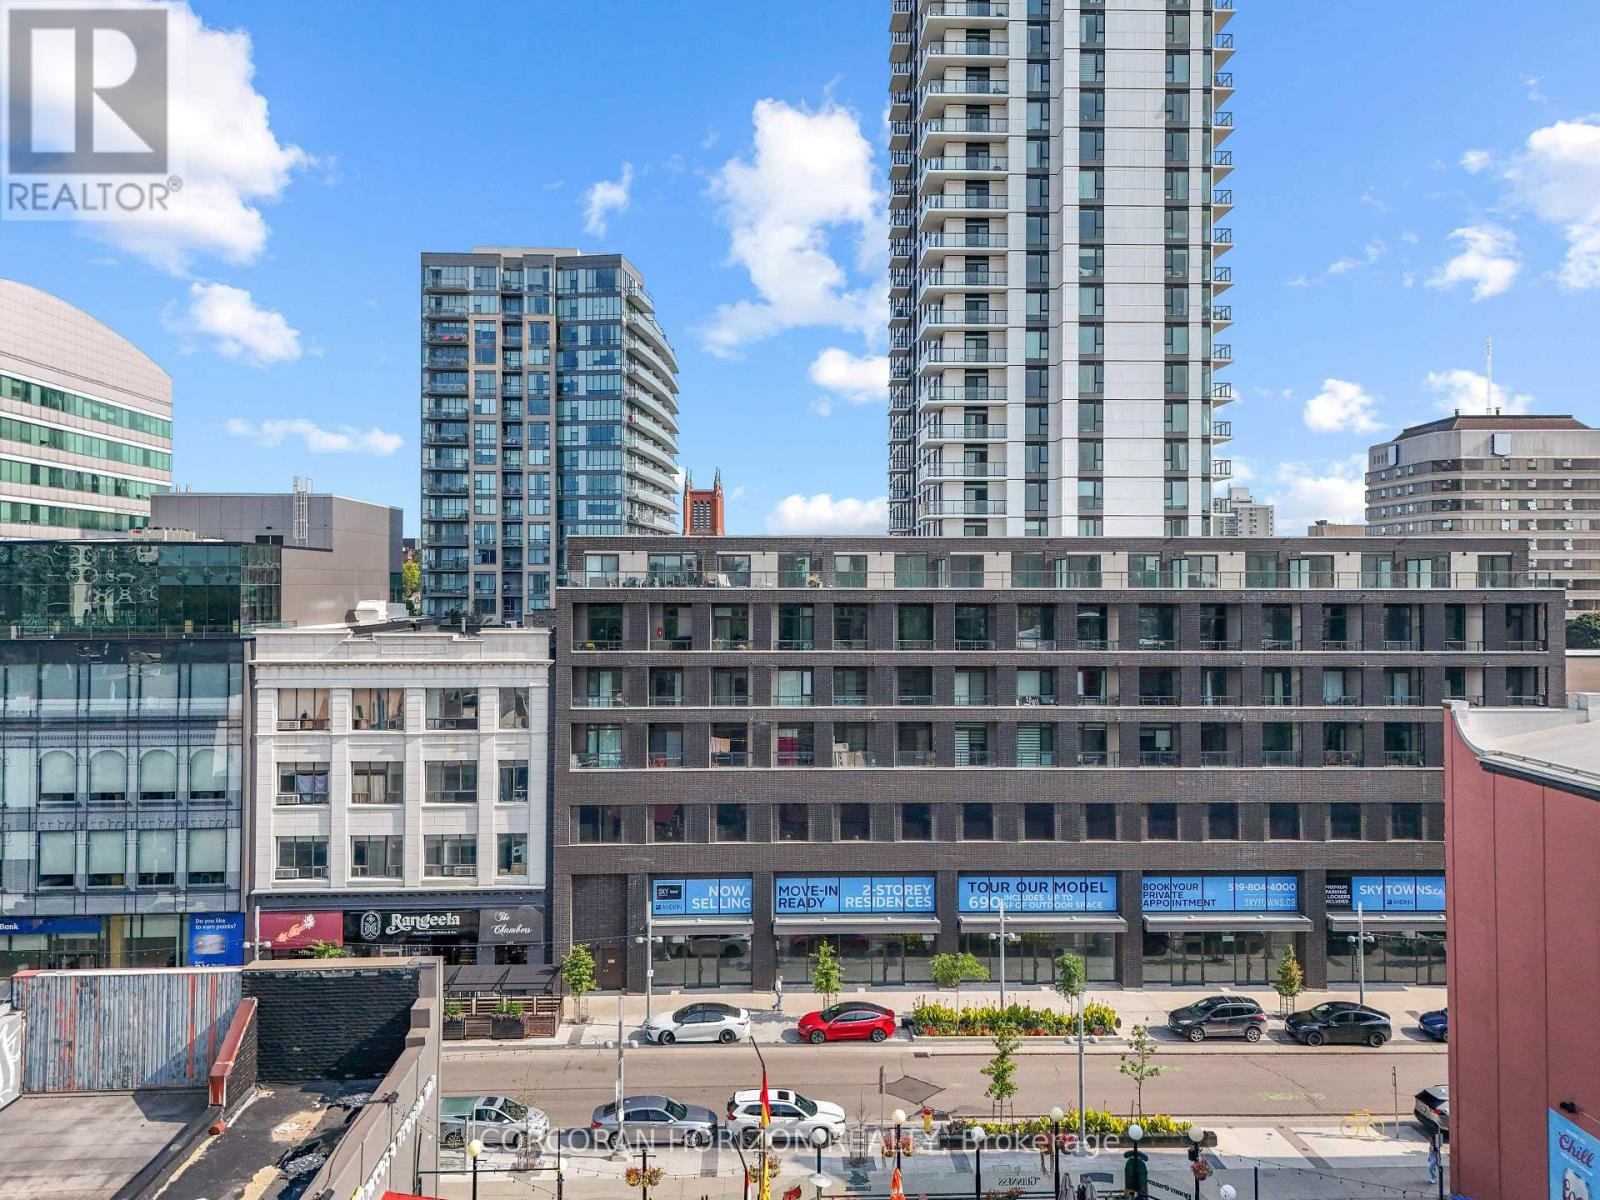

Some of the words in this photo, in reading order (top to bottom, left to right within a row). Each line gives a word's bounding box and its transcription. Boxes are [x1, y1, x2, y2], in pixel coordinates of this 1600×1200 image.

[708, 885, 745, 897] NOW
[778, 885, 838, 896] MOVE-IN
[862, 884, 930, 896] 2-STOREY
[968, 882, 1009, 893] TOUR
[1016, 882, 1048, 893] OUR
[1054, 882, 1108, 893] MODEL
[1143, 883, 1169, 891] BOOK
[1172, 883, 1198, 891] YOUR
[1228, 883, 1296, 892] 519-804-4000
[692, 897, 751, 909] SELLING
[778, 897, 826, 908] READY
[845, 896, 932, 908] RESIDENCES
[969, 896, 1001, 909] 690
[0, 922, 19, 930] Bank
[385, 913, 460, 934] Rangeela
[490, 923, 532, 936] Chambers
[1558, 1133, 1595, 1168] Chill
